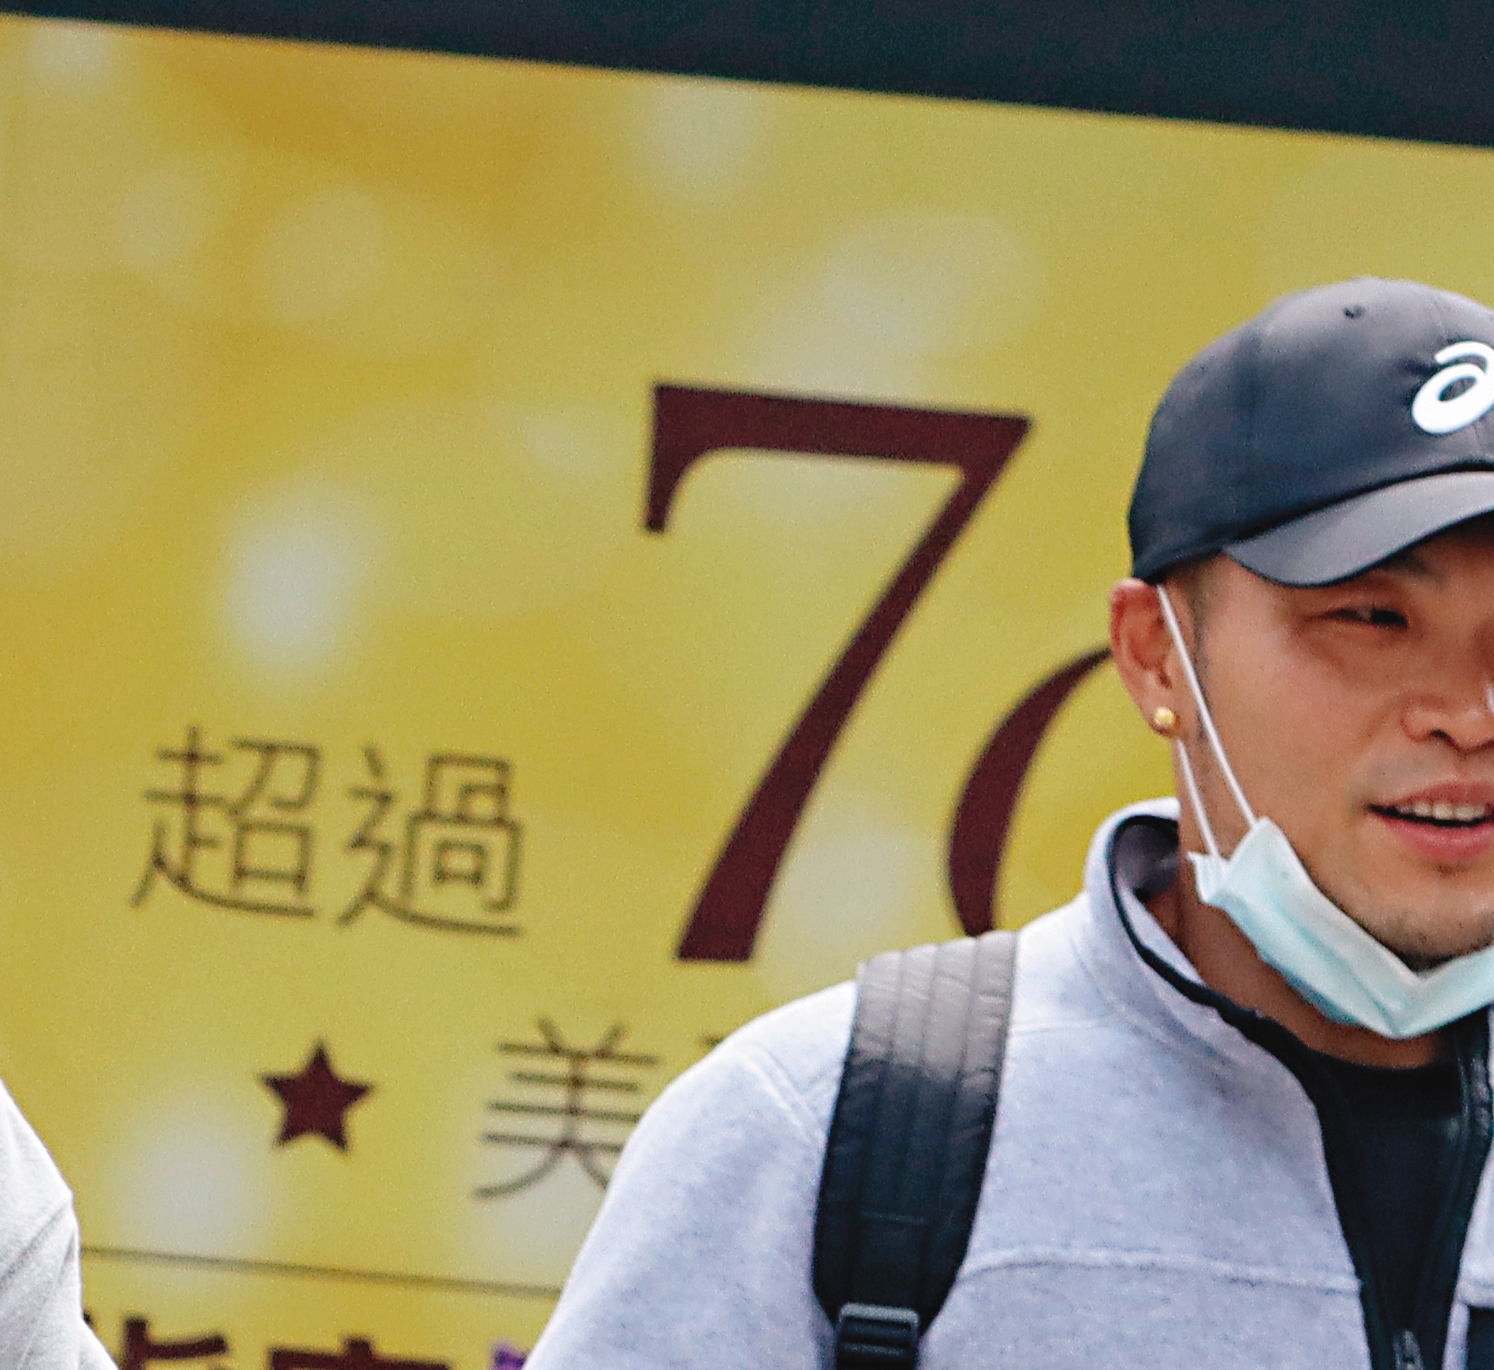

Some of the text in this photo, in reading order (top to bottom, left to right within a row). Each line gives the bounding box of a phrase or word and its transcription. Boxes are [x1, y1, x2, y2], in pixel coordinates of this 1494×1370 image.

[130, 724, 524, 938] 超過
[639, 380, 1114, 964] 7
[472, 1014, 724, 1204] 美
